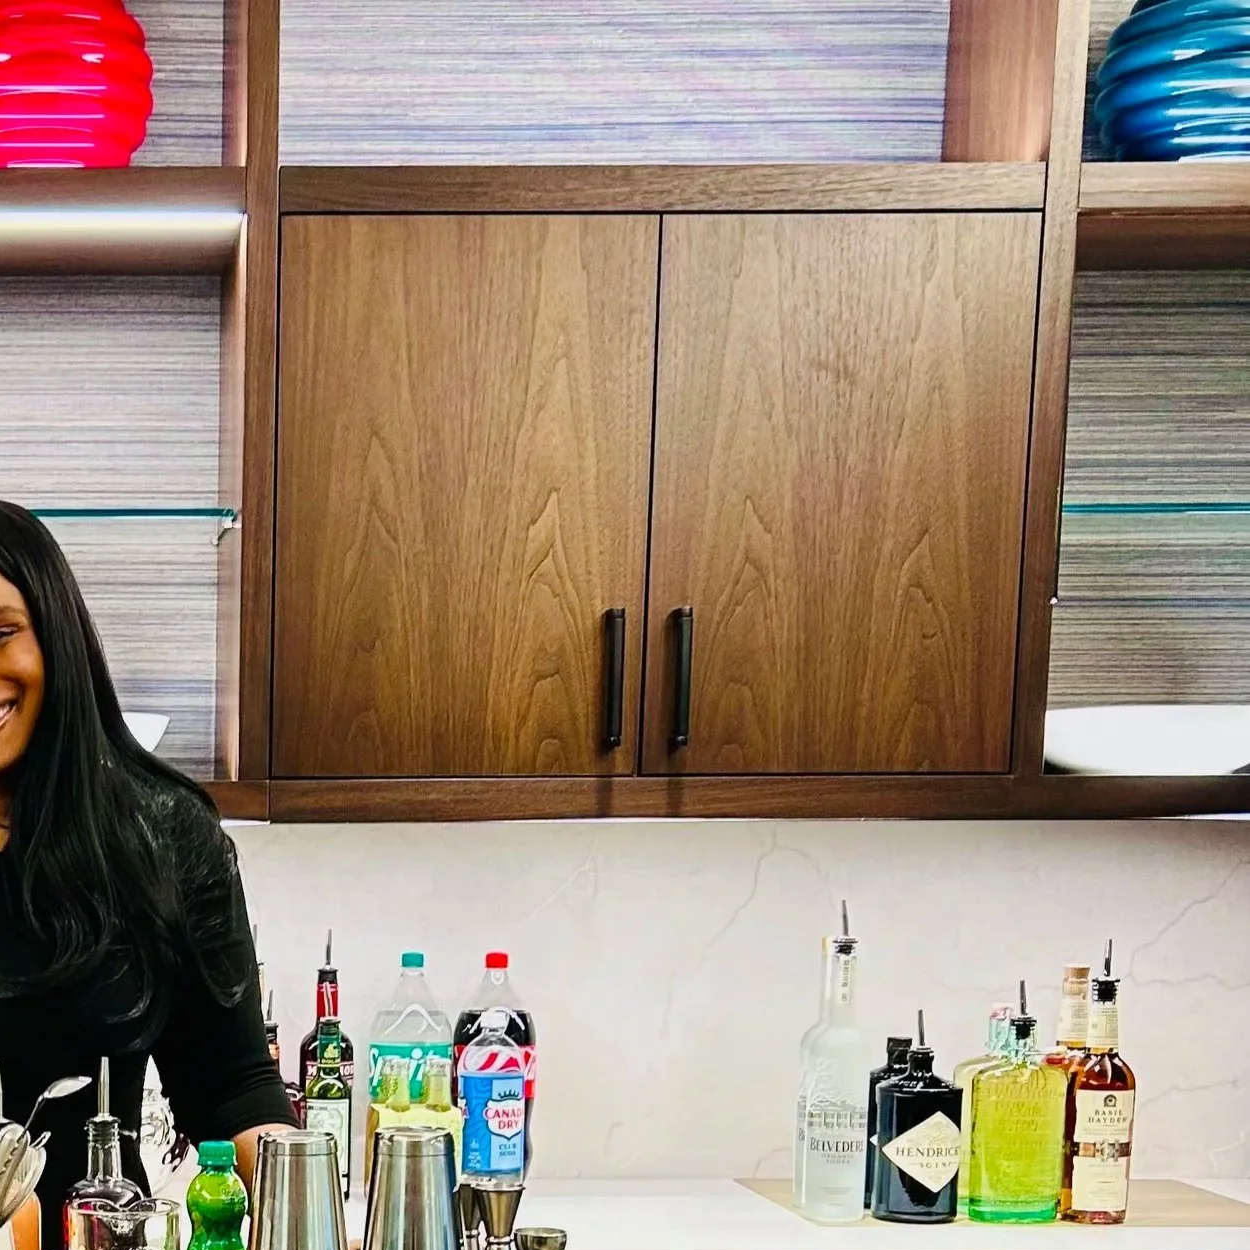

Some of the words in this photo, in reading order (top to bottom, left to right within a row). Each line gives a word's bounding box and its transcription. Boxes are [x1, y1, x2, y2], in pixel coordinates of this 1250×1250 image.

[484, 1107, 522, 1120] CANAD
[498, 1120, 519, 1130] DRY
[1088, 1116, 1128, 1124] HAYDEN
[810, 1136, 864, 1153] BELVEDERE
